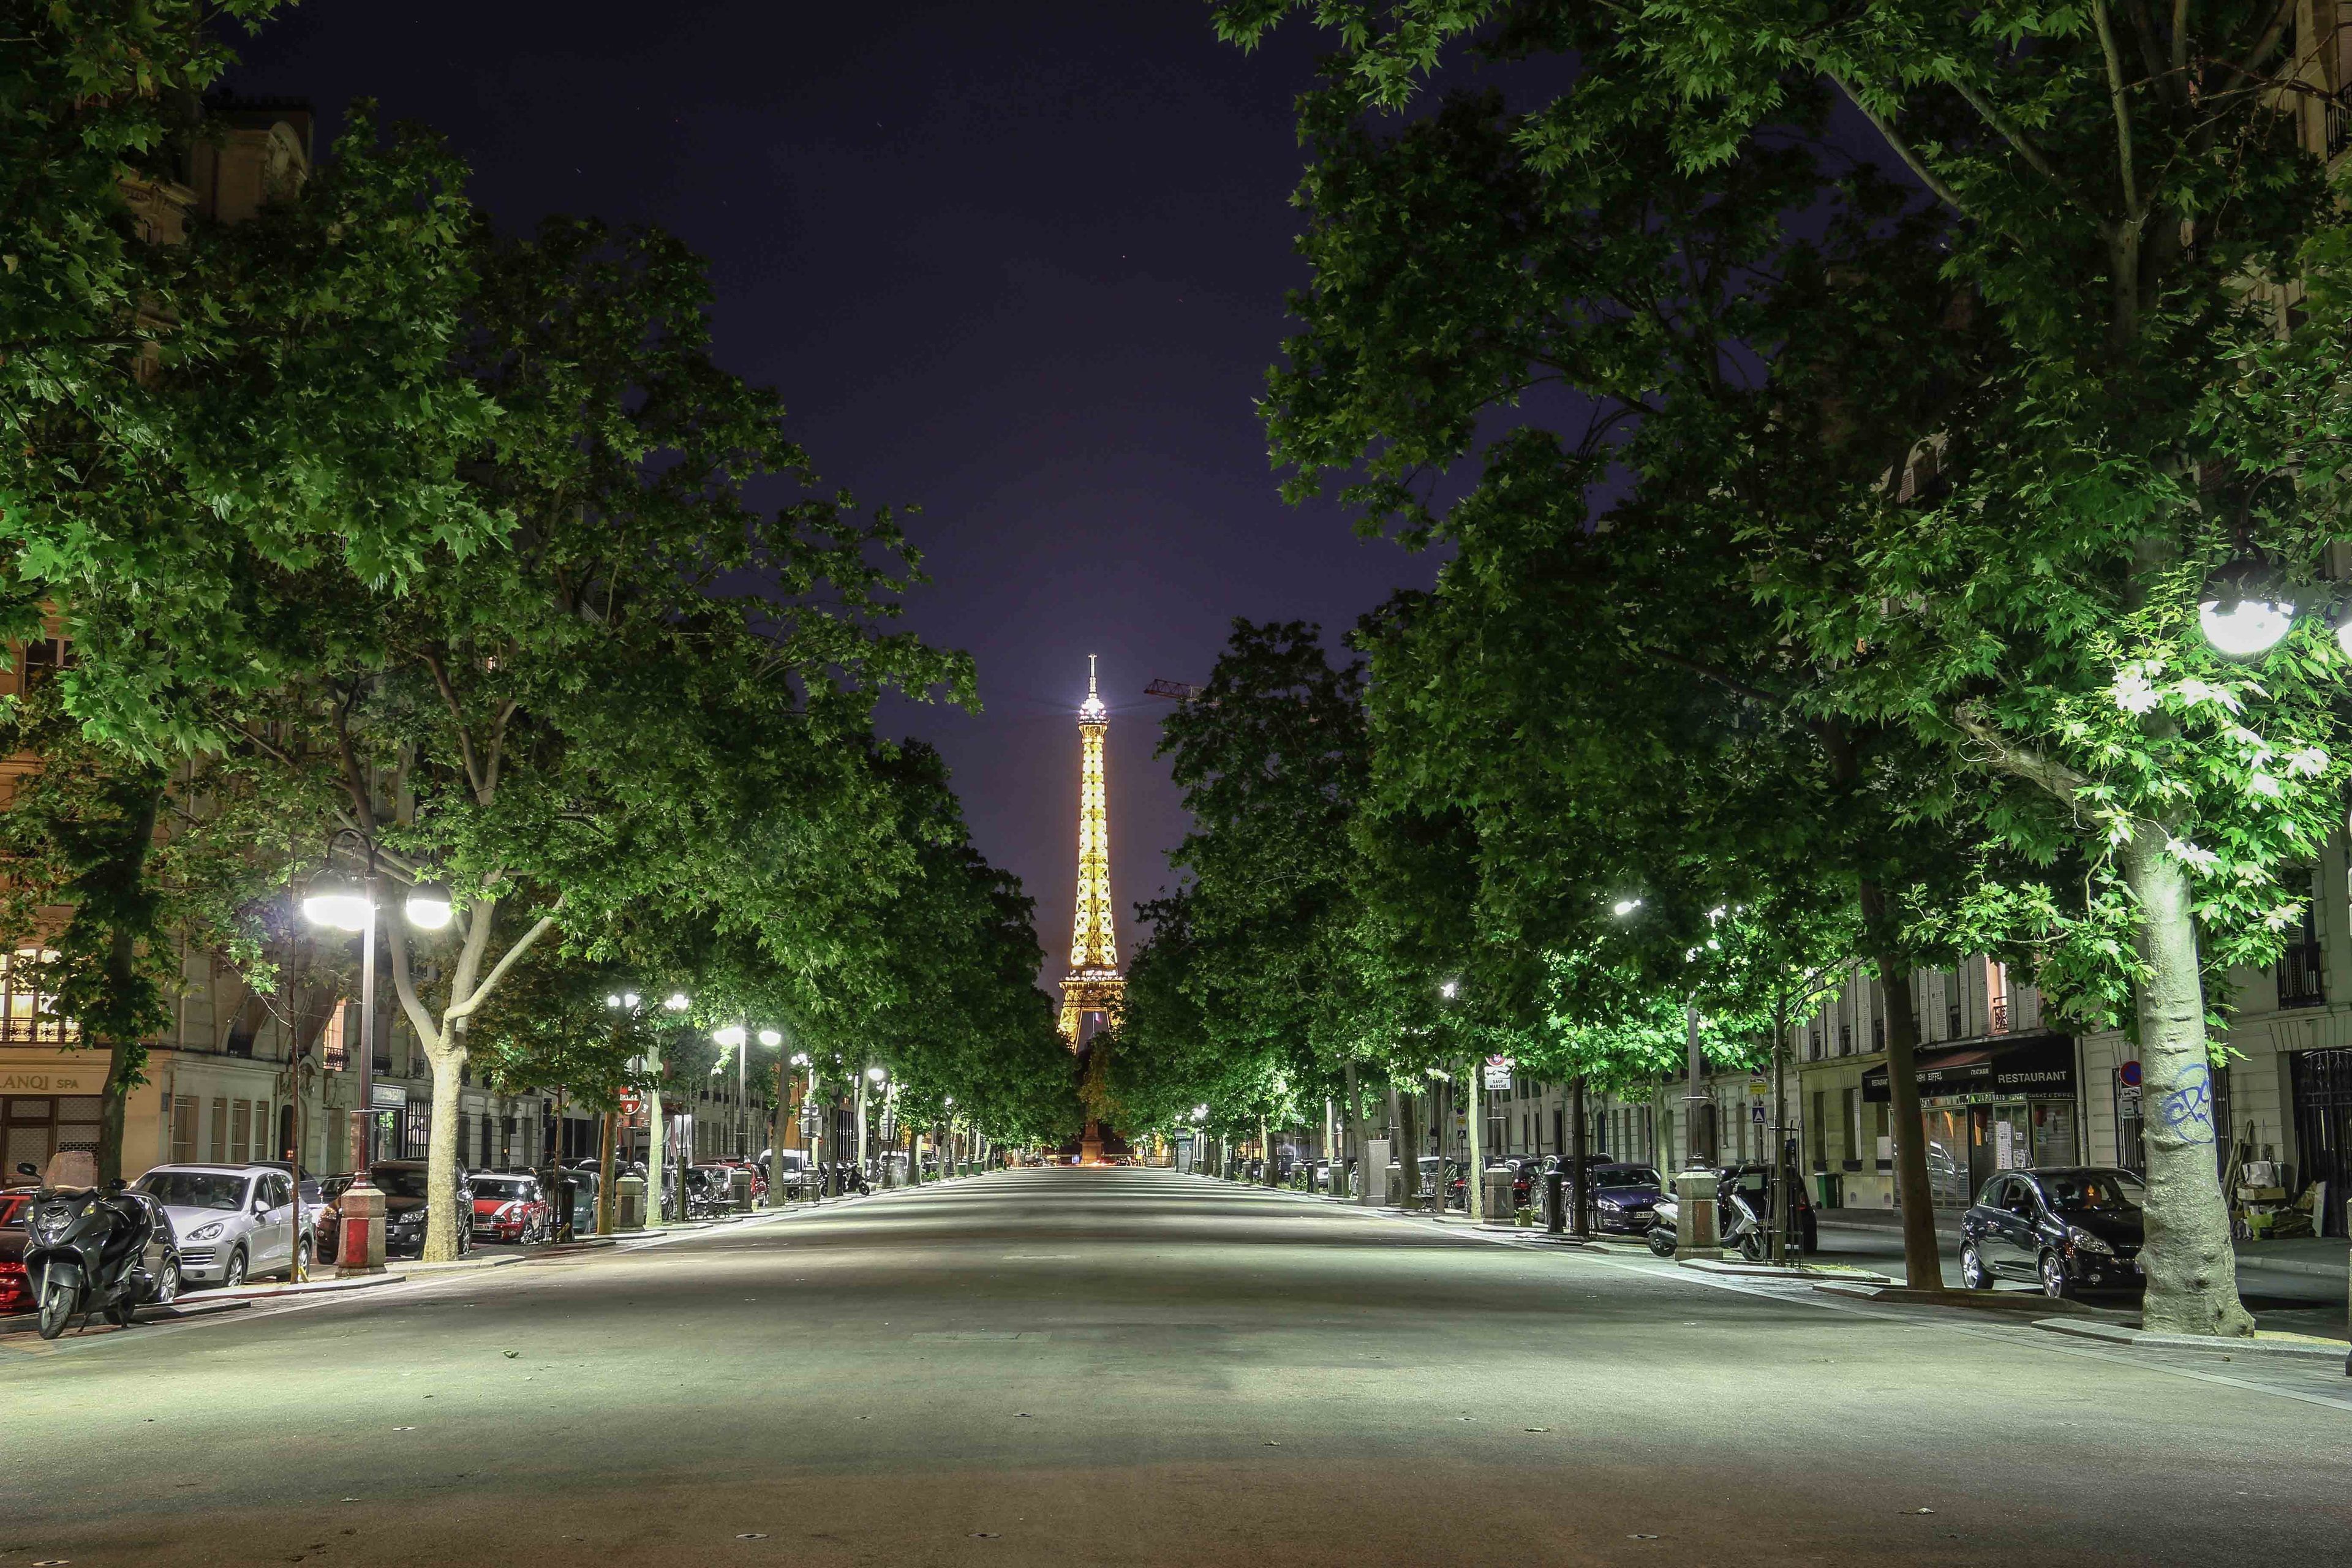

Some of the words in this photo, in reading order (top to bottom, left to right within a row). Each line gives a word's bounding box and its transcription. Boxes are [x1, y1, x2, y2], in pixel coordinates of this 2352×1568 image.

[1928, 1071, 1942, 1081] EIFFEL
[1998, 1071, 2067, 1084] RESTAURANT
[0, 1076, 48, 1090] ANQI
[56, 1080, 78, 1088] SPA
